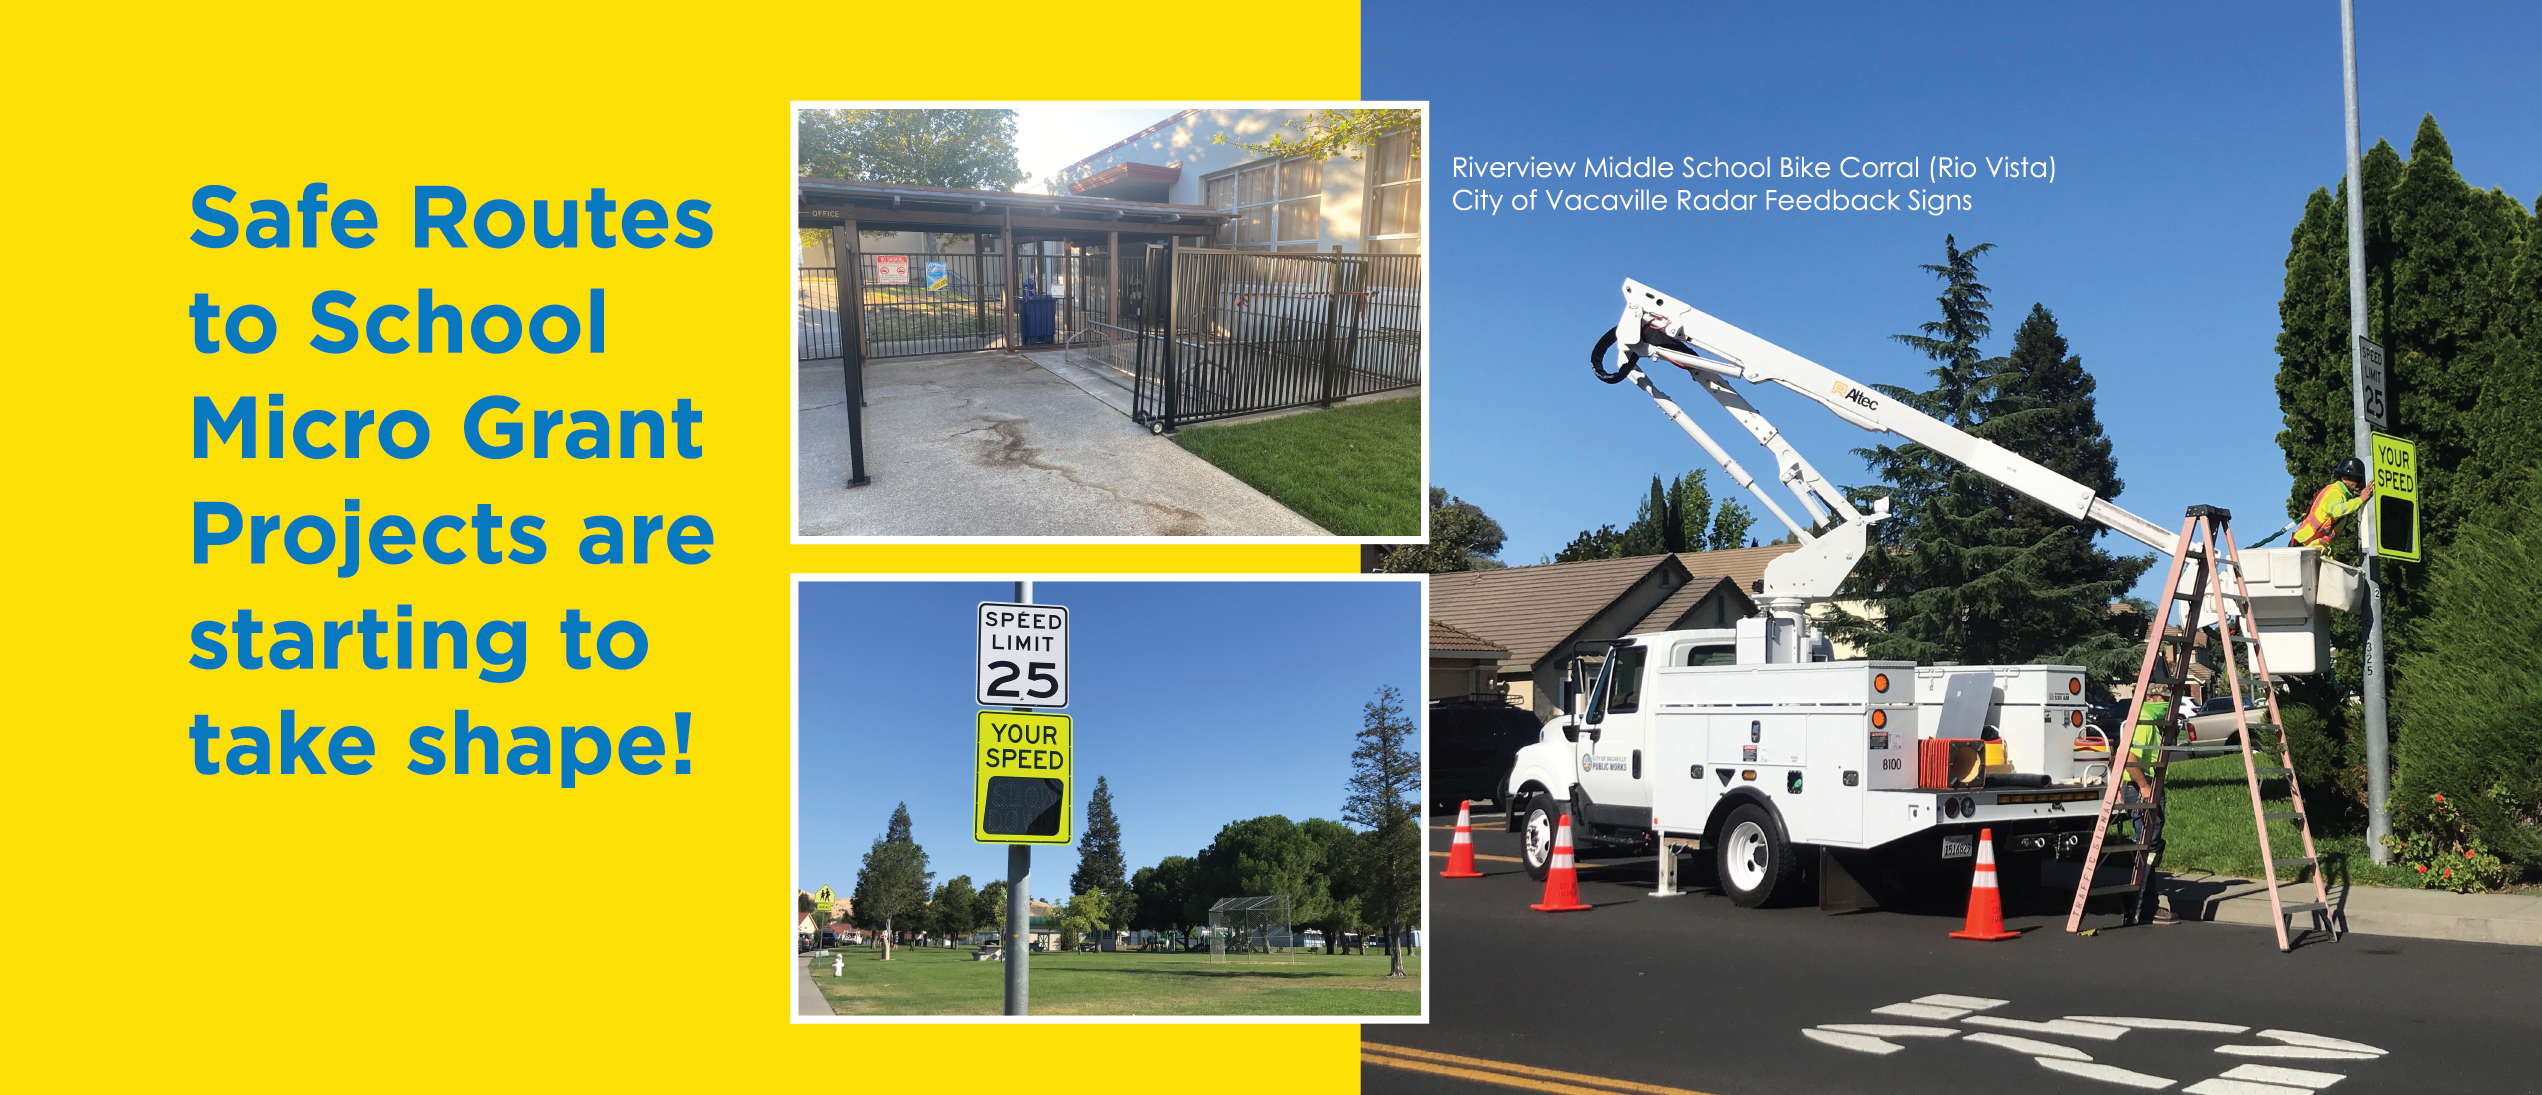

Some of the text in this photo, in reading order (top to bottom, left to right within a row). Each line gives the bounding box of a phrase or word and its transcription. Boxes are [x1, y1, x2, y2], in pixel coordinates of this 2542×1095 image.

[812, 210, 839, 218] OFFICE
[2363, 346, 2382, 366] SPEED
[2364, 365, 2381, 384] LIMIT
[1844, 388, 1879, 411] Altec
[2365, 385, 2384, 418] 25
[2378, 444, 2410, 470] YOUR
[2378, 468, 2414, 493] SPEED
[2375, 589, 2380, 598] 2
[985, 611, 1062, 630] SPEED
[992, 634, 1054, 652] LIMIT
[986, 660, 1059, 699] 25
[991, 723, 1057, 745] YOUR
[985, 748, 1064, 770] SPEED
[1593, 762, 1627, 771] PUBLIC WORKS
[1883, 758, 1901, 770] 8100
[2073, 800, 2113, 919] TRAFFIC SIGNAL
